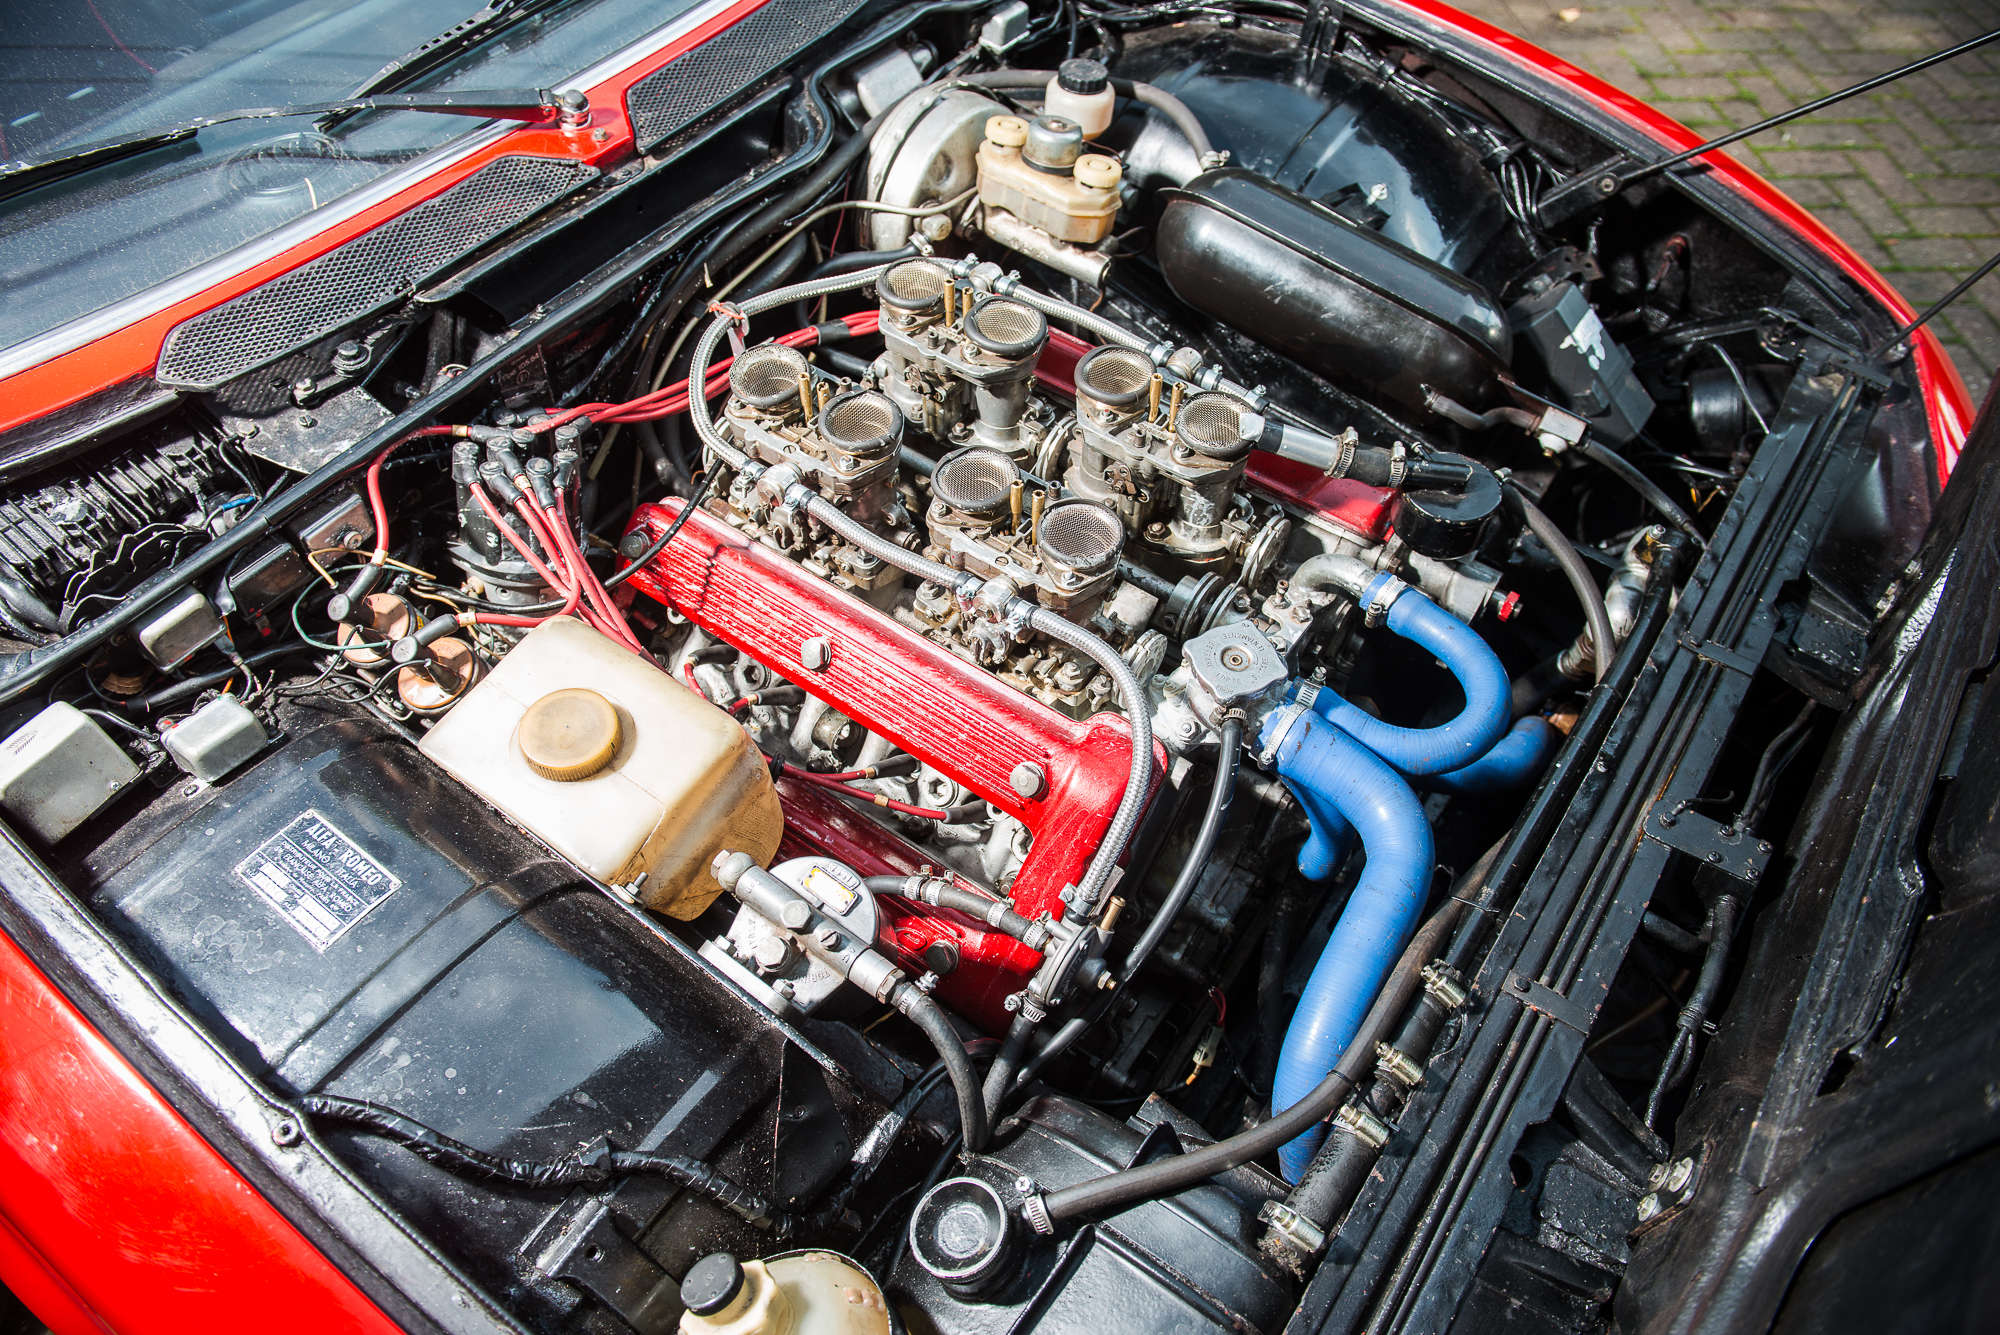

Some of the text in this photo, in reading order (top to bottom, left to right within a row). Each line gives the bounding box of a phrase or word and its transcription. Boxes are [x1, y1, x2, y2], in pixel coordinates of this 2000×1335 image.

[300, 839, 358, 888] MILANO ITALIA
[304, 822, 338, 848] ALFA
[338, 849, 384, 886] ROMEO
